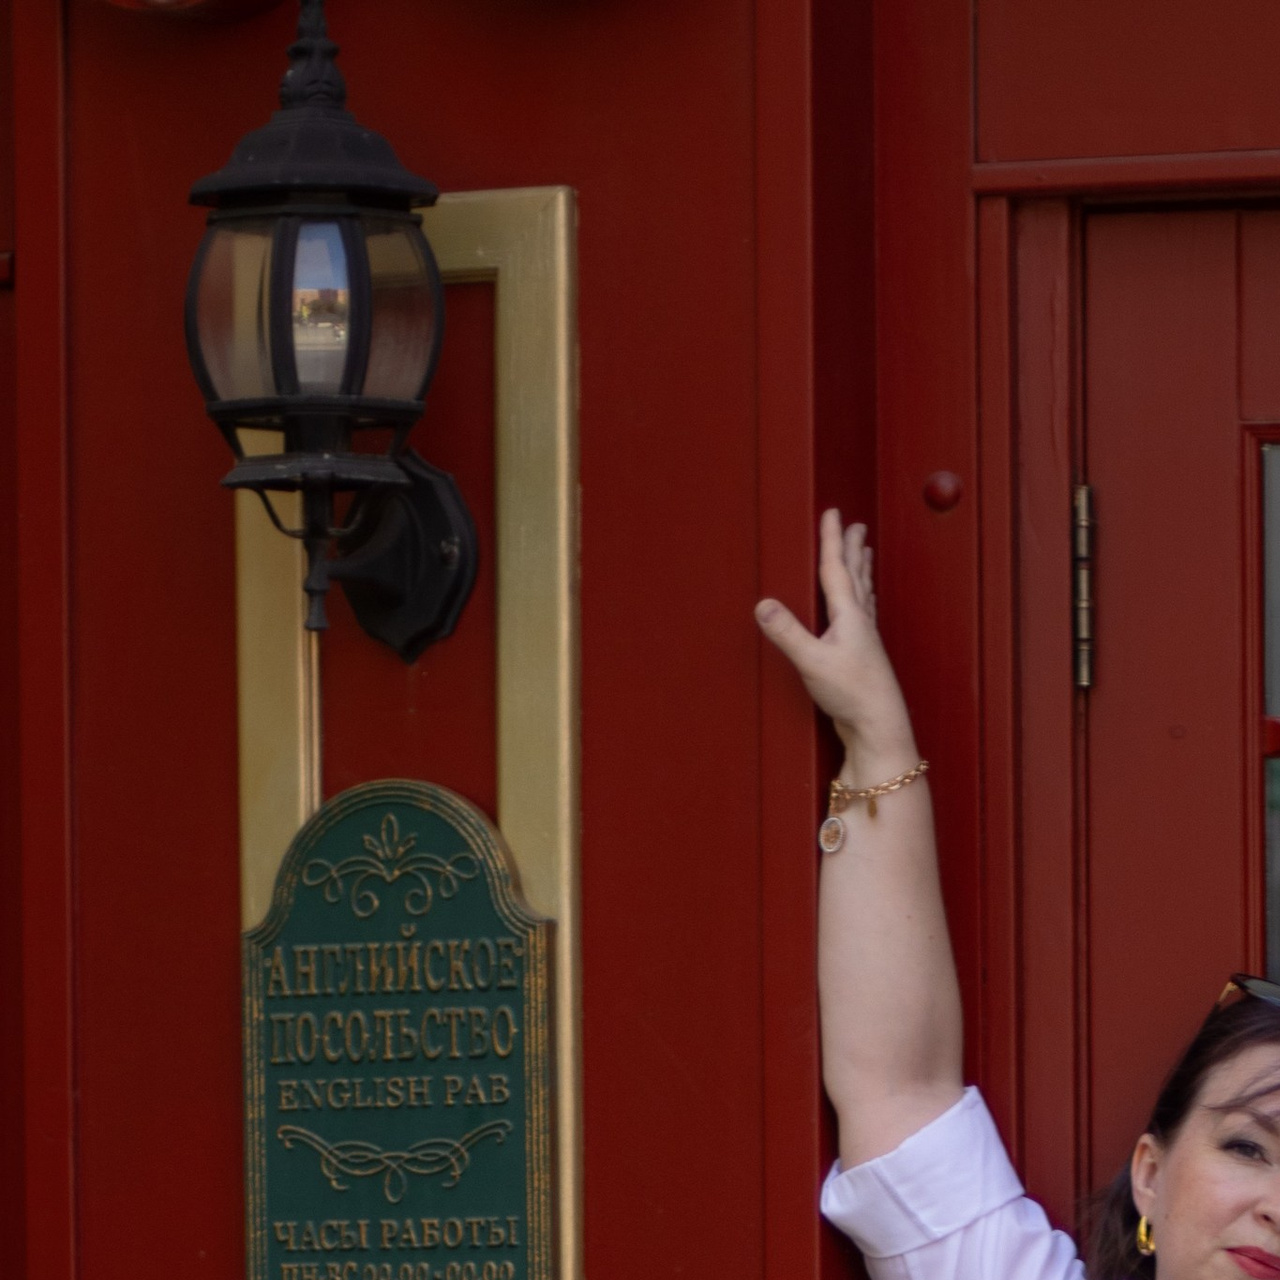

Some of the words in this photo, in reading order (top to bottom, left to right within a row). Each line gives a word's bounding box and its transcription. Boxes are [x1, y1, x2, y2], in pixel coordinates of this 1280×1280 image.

[267, 924, 518, 997] АНГЛИЙСКОЕ
[270, 1004, 518, 1064] ПОСОЛЬСТВО
[277, 1076, 433, 1111] ENGLISH
[443, 1073, 512, 1106] PAB
[273, 1219, 371, 1251] ЧАСЫ
[379, 1216, 520, 1249] РАБОТЫ
